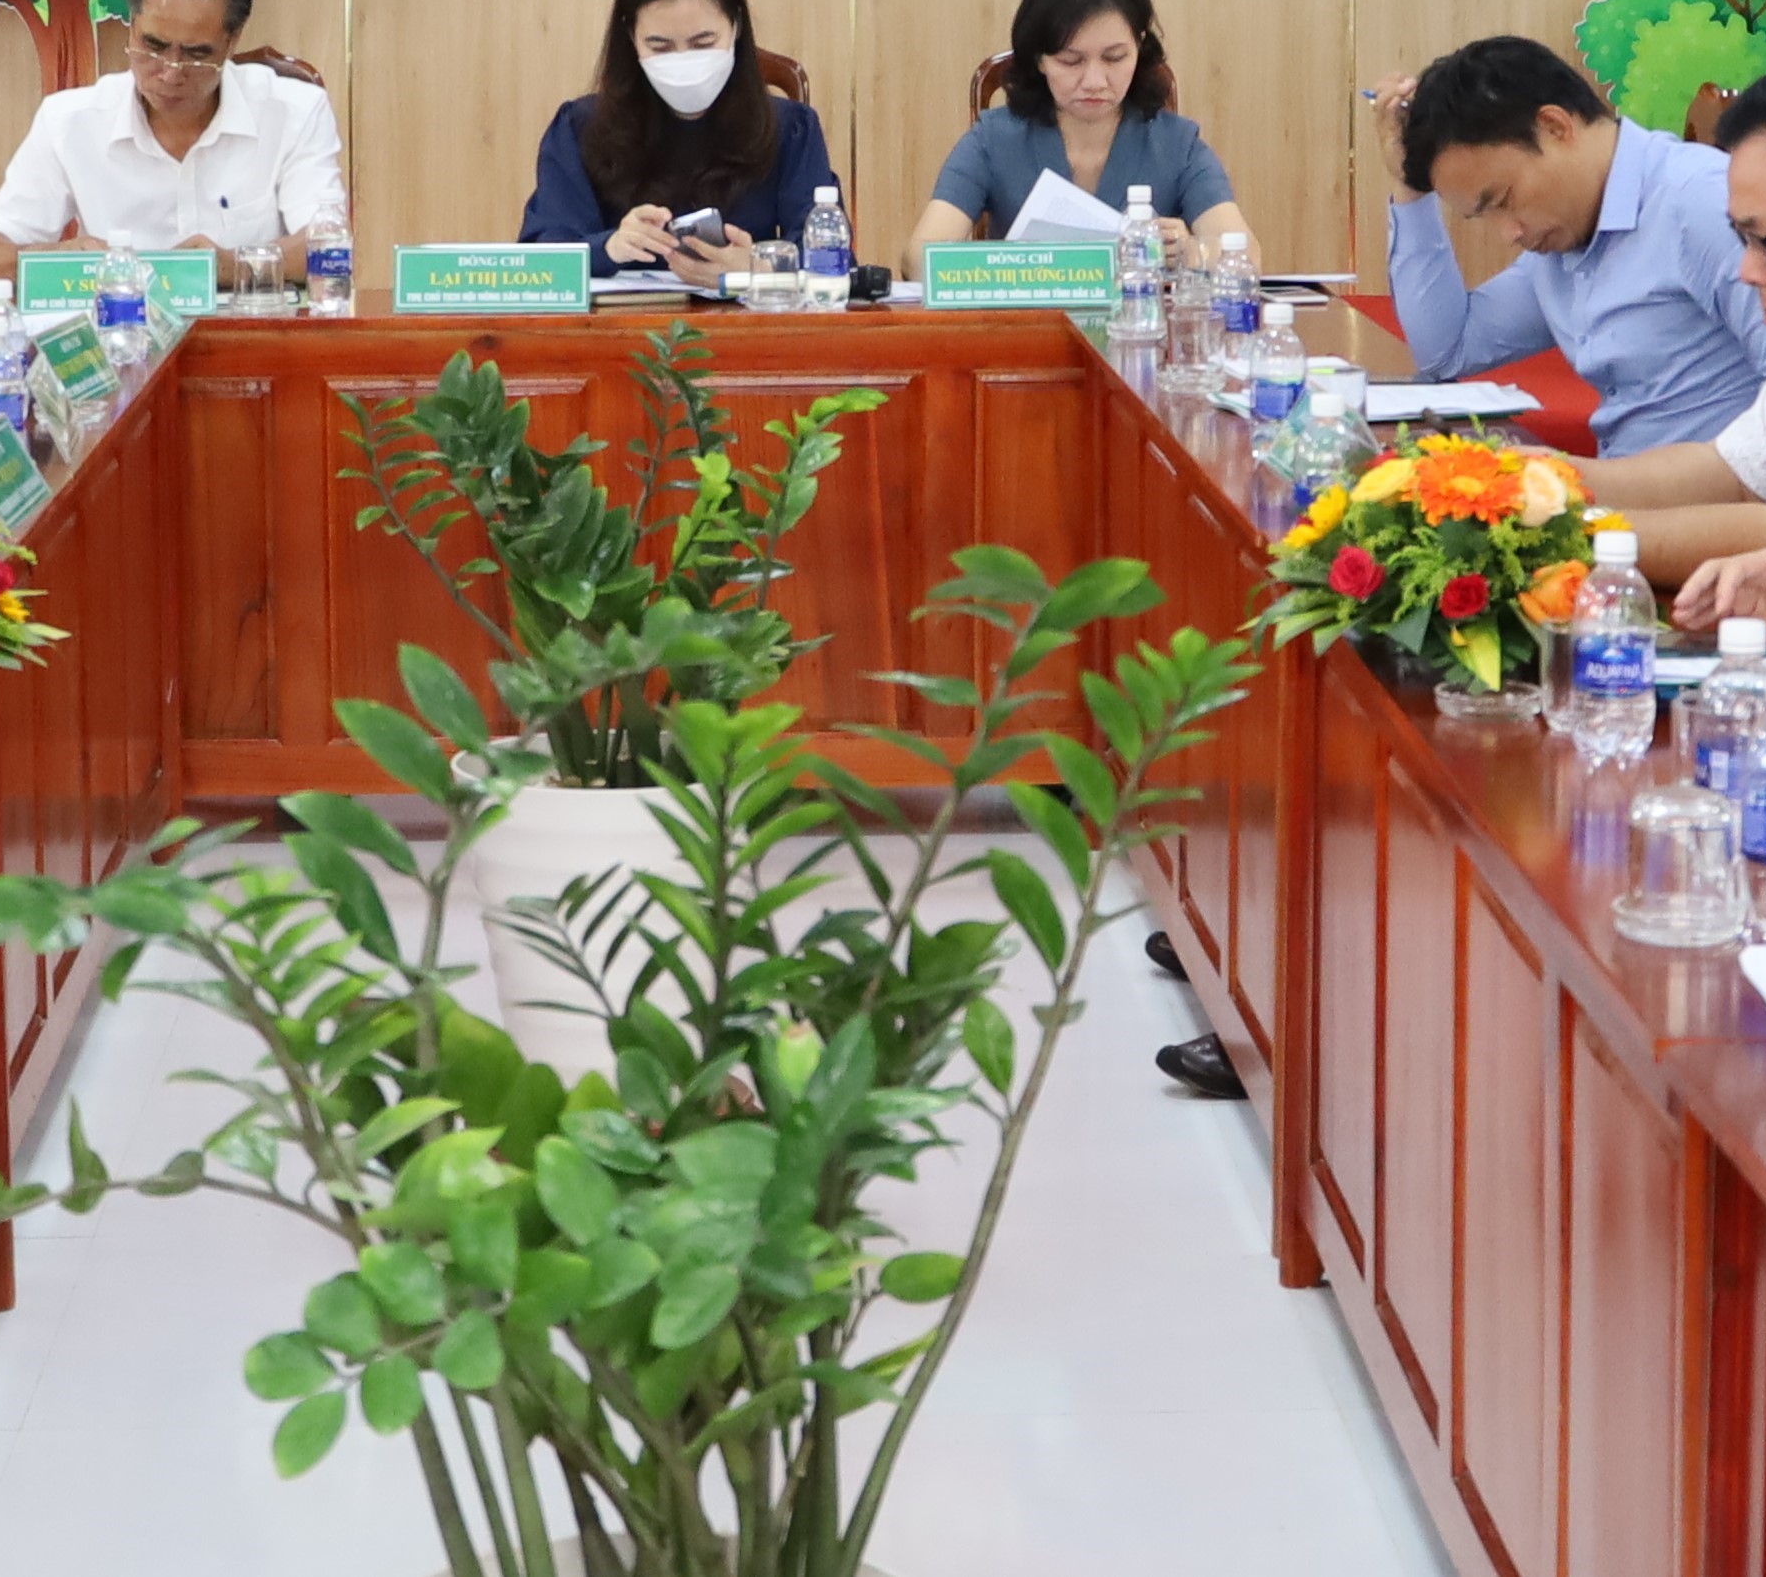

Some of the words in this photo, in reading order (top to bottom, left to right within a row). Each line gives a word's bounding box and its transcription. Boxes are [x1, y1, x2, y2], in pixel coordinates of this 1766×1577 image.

[430, 271, 461, 289] LẠI
[465, 271, 497, 289] THỊ
[502, 271, 553, 285] LOAN
[1068, 269, 1105, 282] LOAN
